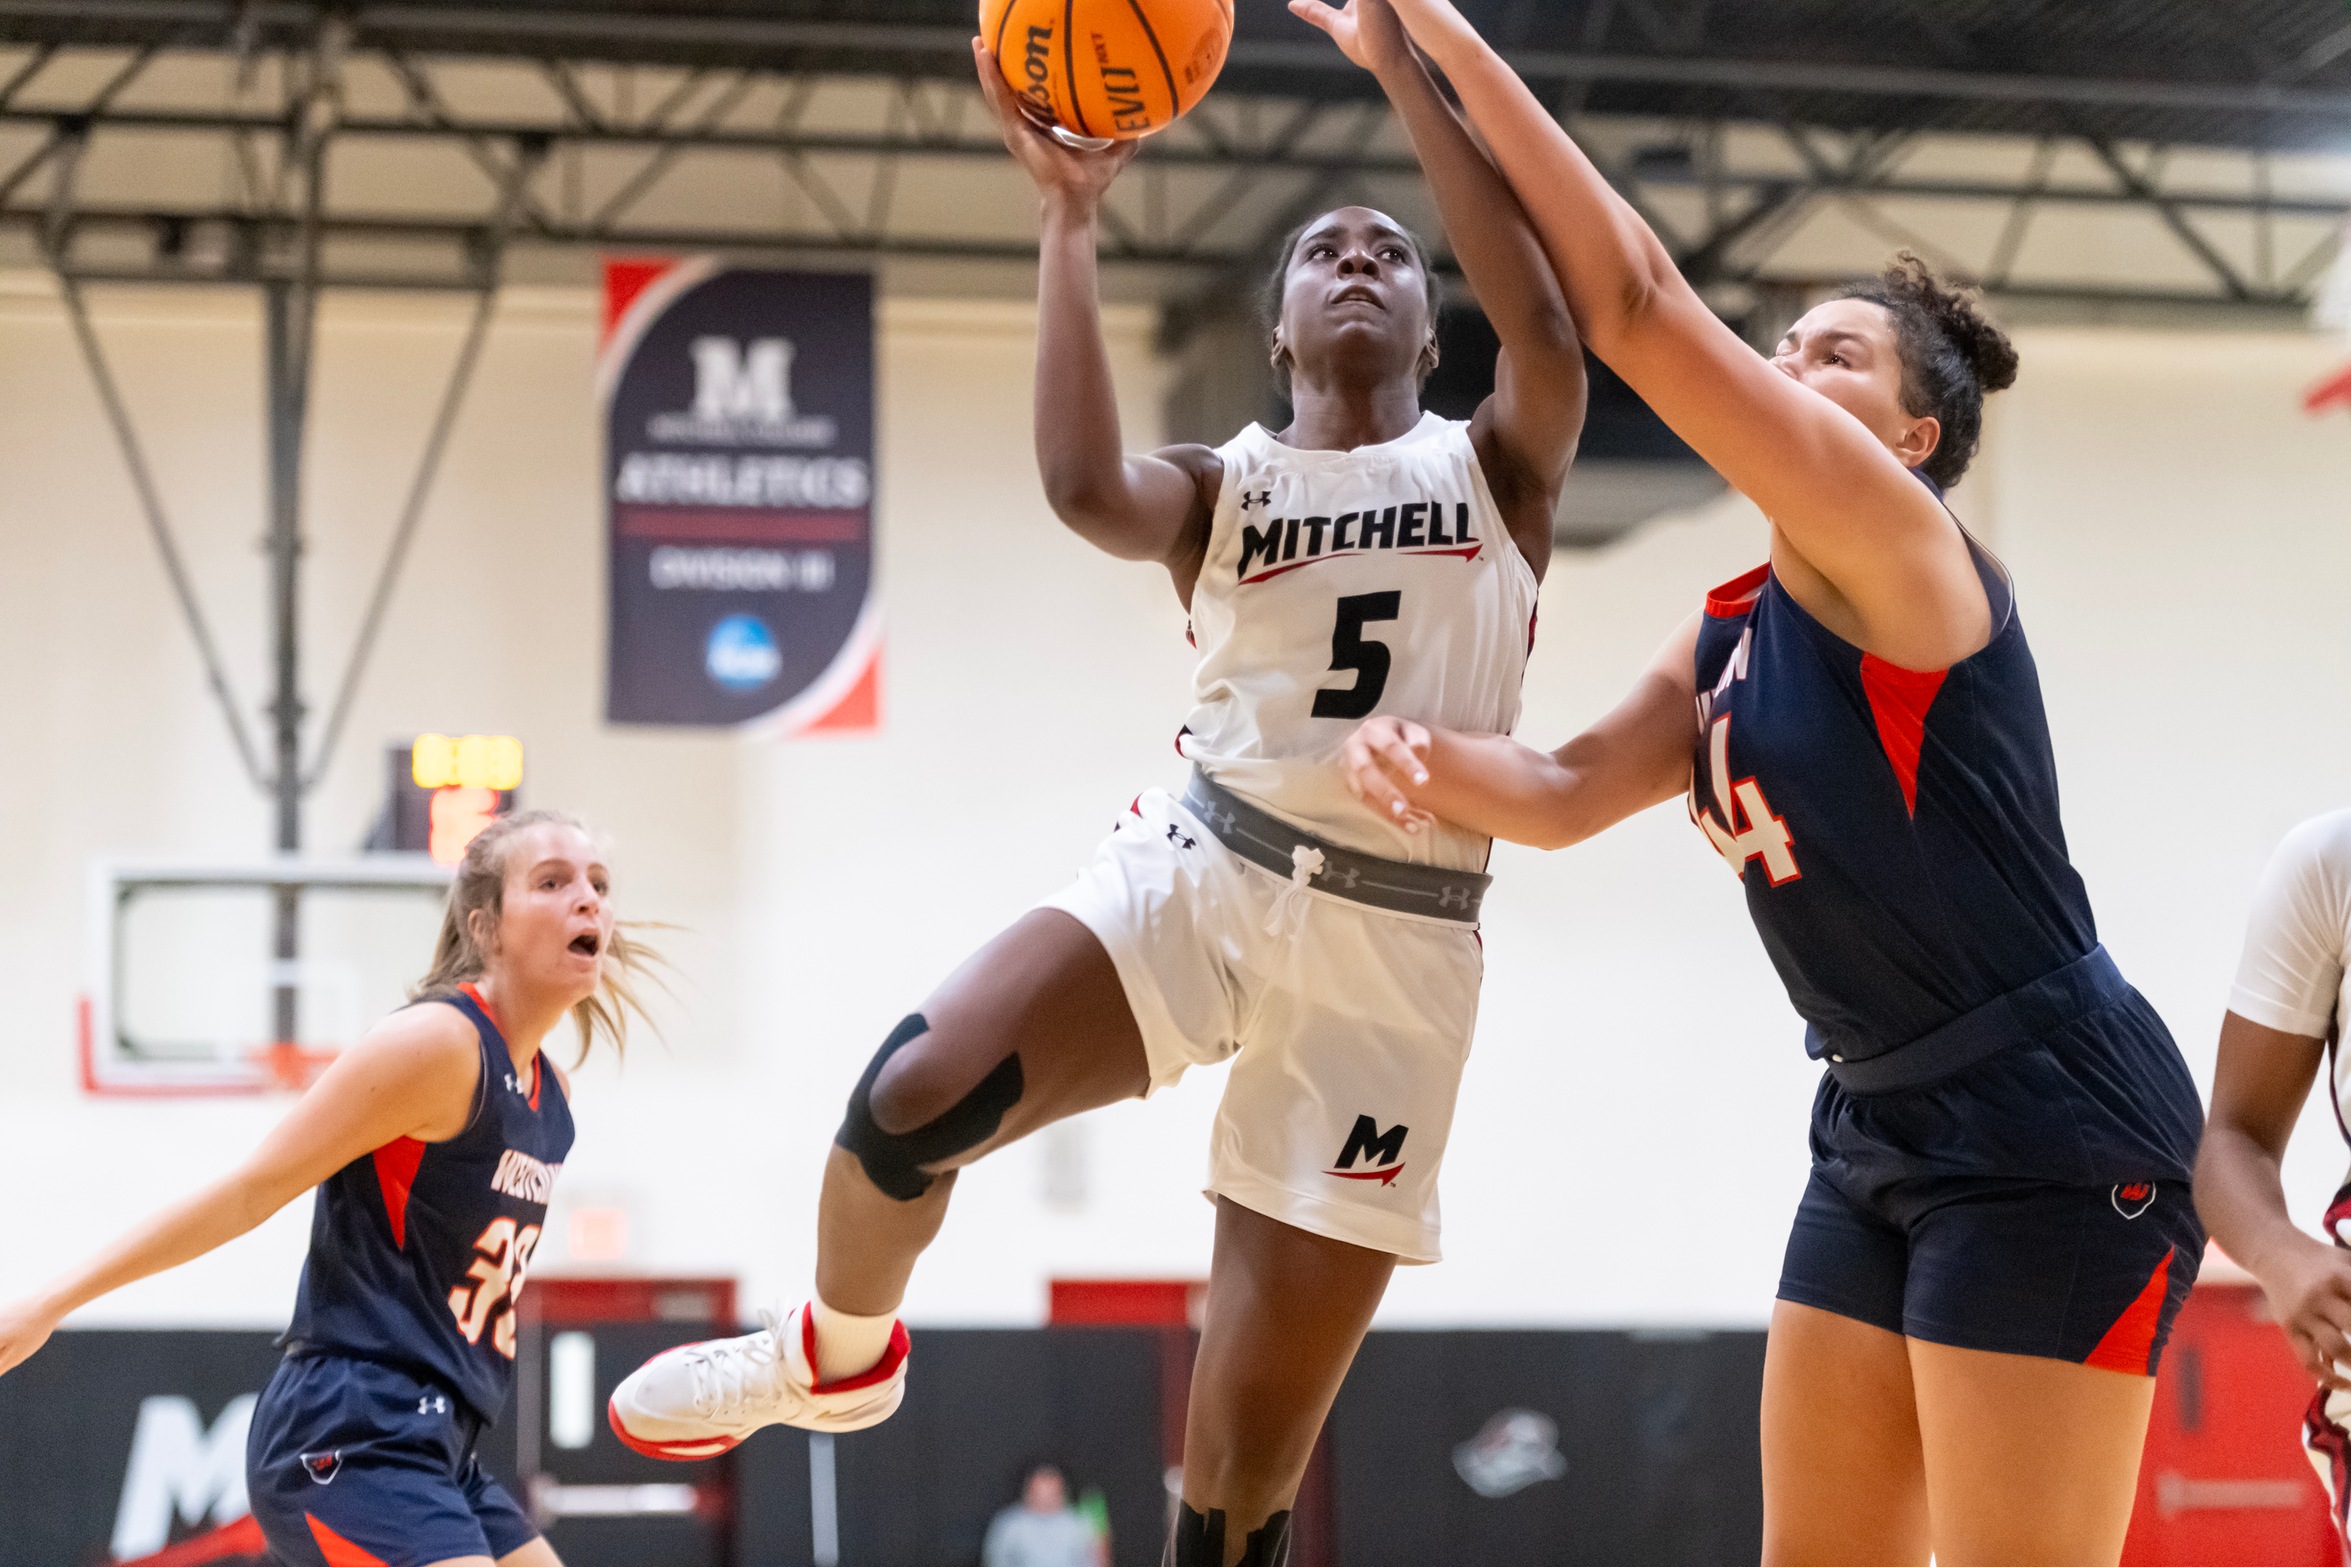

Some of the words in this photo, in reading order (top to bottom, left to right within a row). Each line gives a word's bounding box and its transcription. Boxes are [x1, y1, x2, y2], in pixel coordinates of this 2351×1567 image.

[690, 336, 796, 424] M
[617, 453, 870, 507] ATHLETICS
[1237, 501, 1480, 582] MITCHELL
[1311, 590, 1402, 720] 5
[1334, 1114, 1409, 1169] M
